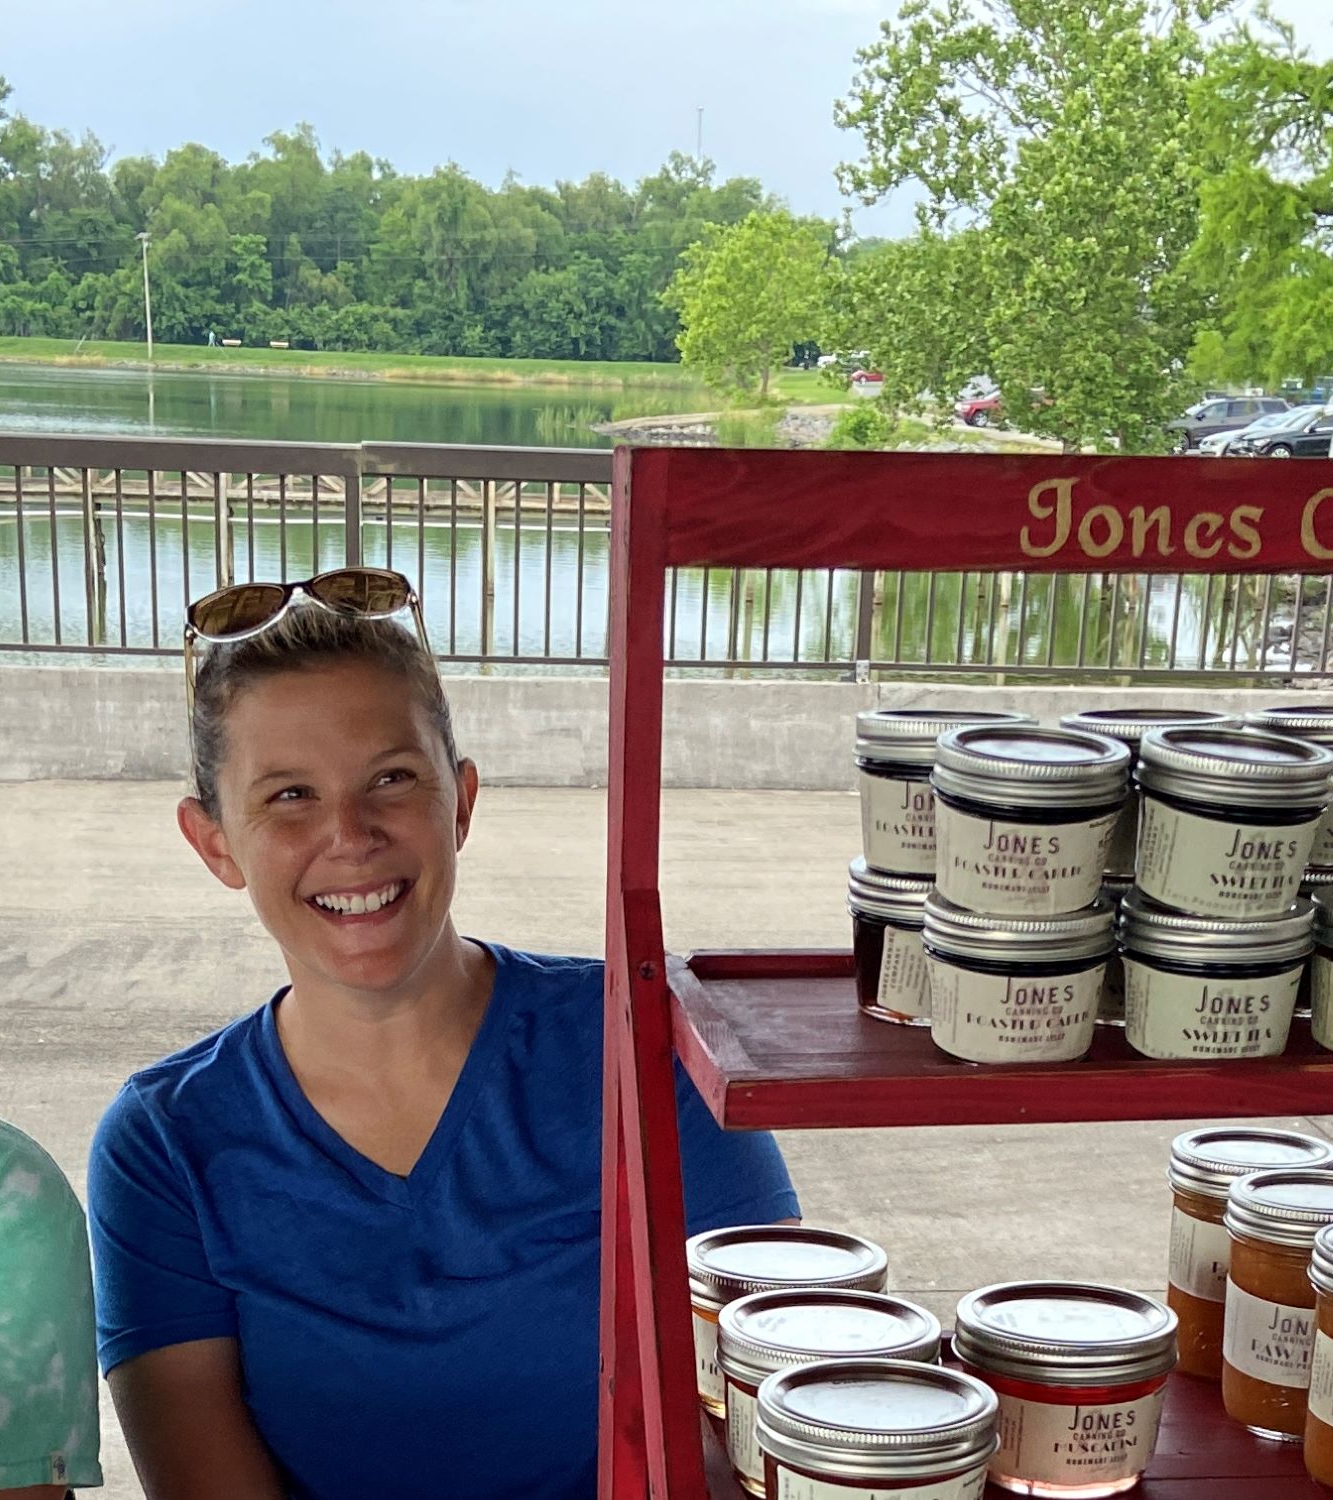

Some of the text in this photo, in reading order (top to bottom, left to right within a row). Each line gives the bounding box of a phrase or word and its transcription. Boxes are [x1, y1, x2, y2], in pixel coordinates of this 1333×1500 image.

[1019, 476, 1265, 559] Jones
[983, 820, 1060, 855] JONES
[1225, 829, 1298, 861] JONES
[1000, 977, 1074, 1005] JONES
[1195, 985, 1271, 1015] JONES
[1068, 1406, 1136, 1431] JONES
